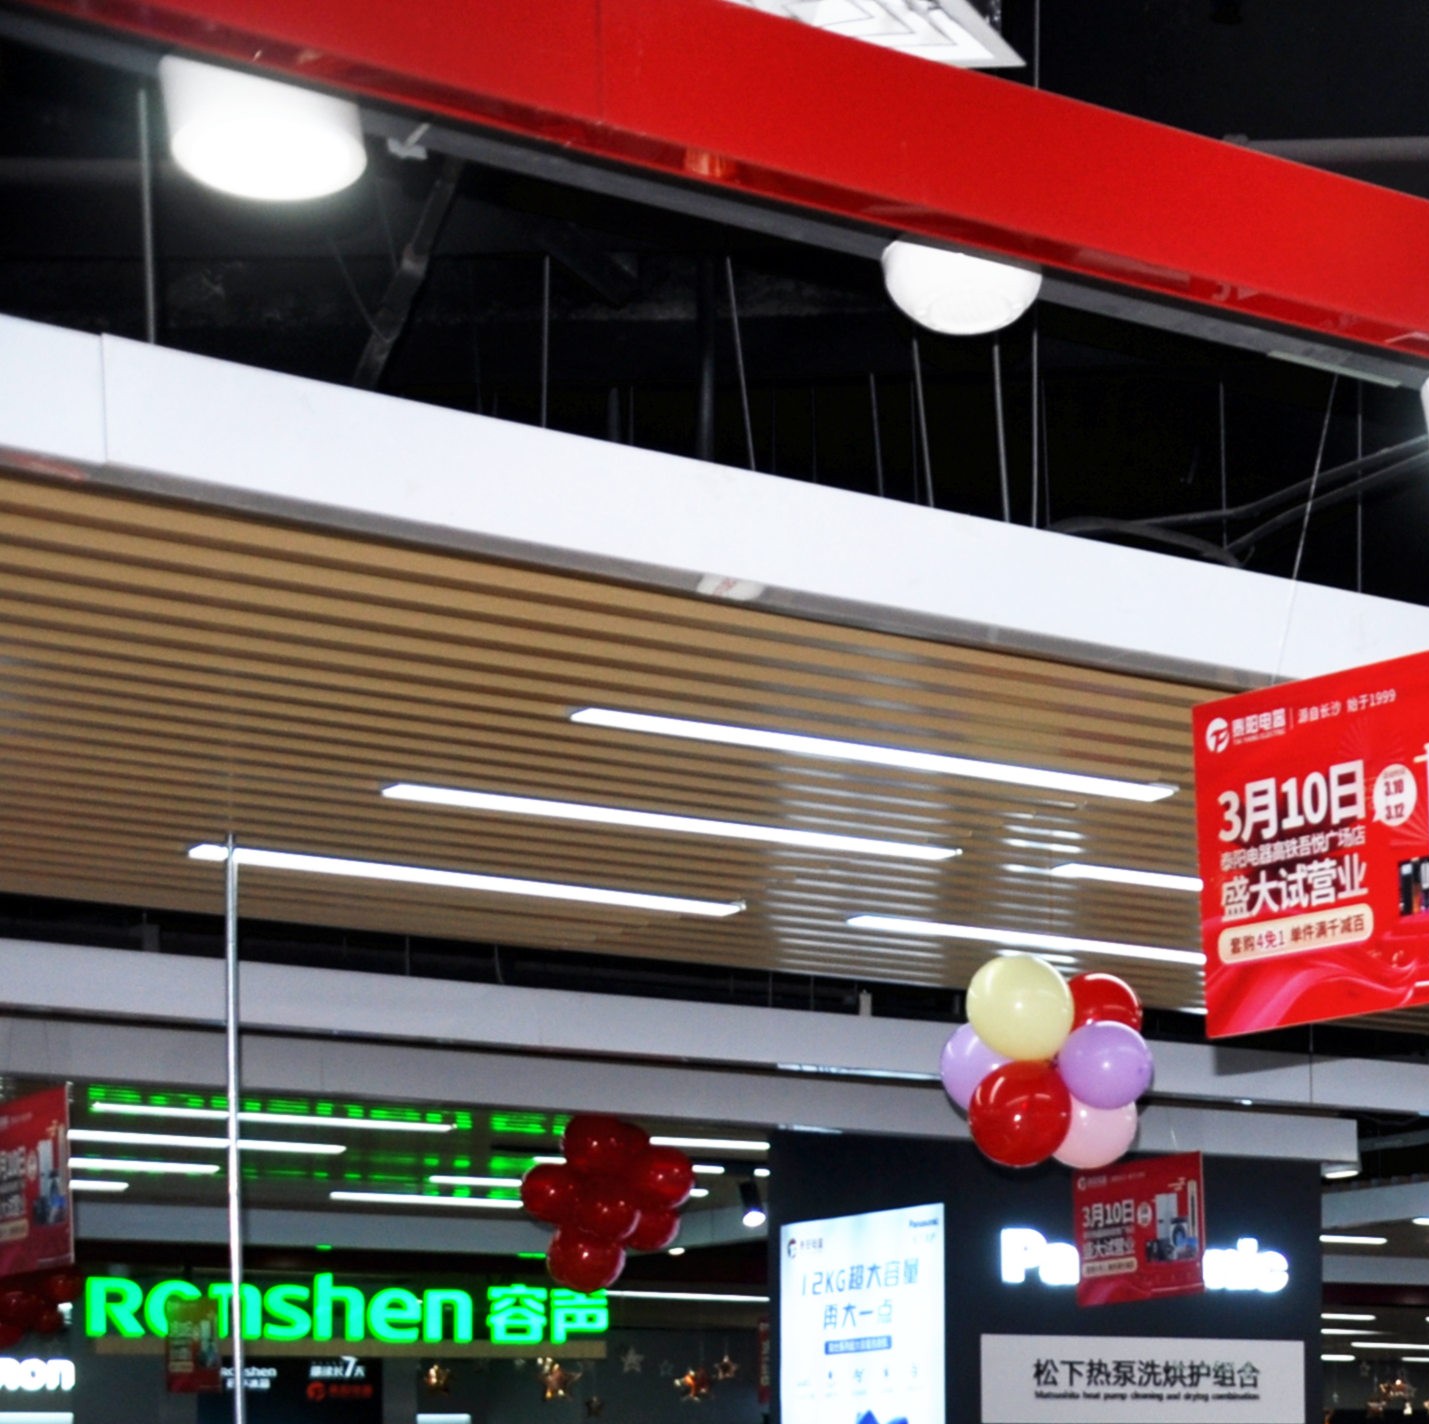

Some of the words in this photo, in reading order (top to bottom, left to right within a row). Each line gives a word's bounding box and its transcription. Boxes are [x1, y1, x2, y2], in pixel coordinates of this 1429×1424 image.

[1218, 759, 1367, 843] 3月10日
[1221, 852, 1369, 923] 盛大试营业
[1081, 1200, 1135, 1228] 3月10日
[801, 1257, 920, 1297] 12KG超大容量
[487, 1282, 609, 1345] 容声
[823, 1298, 893, 1331] 再大一点
[1033, 1358, 1261, 1389] 松下热泵洗烘护组合
